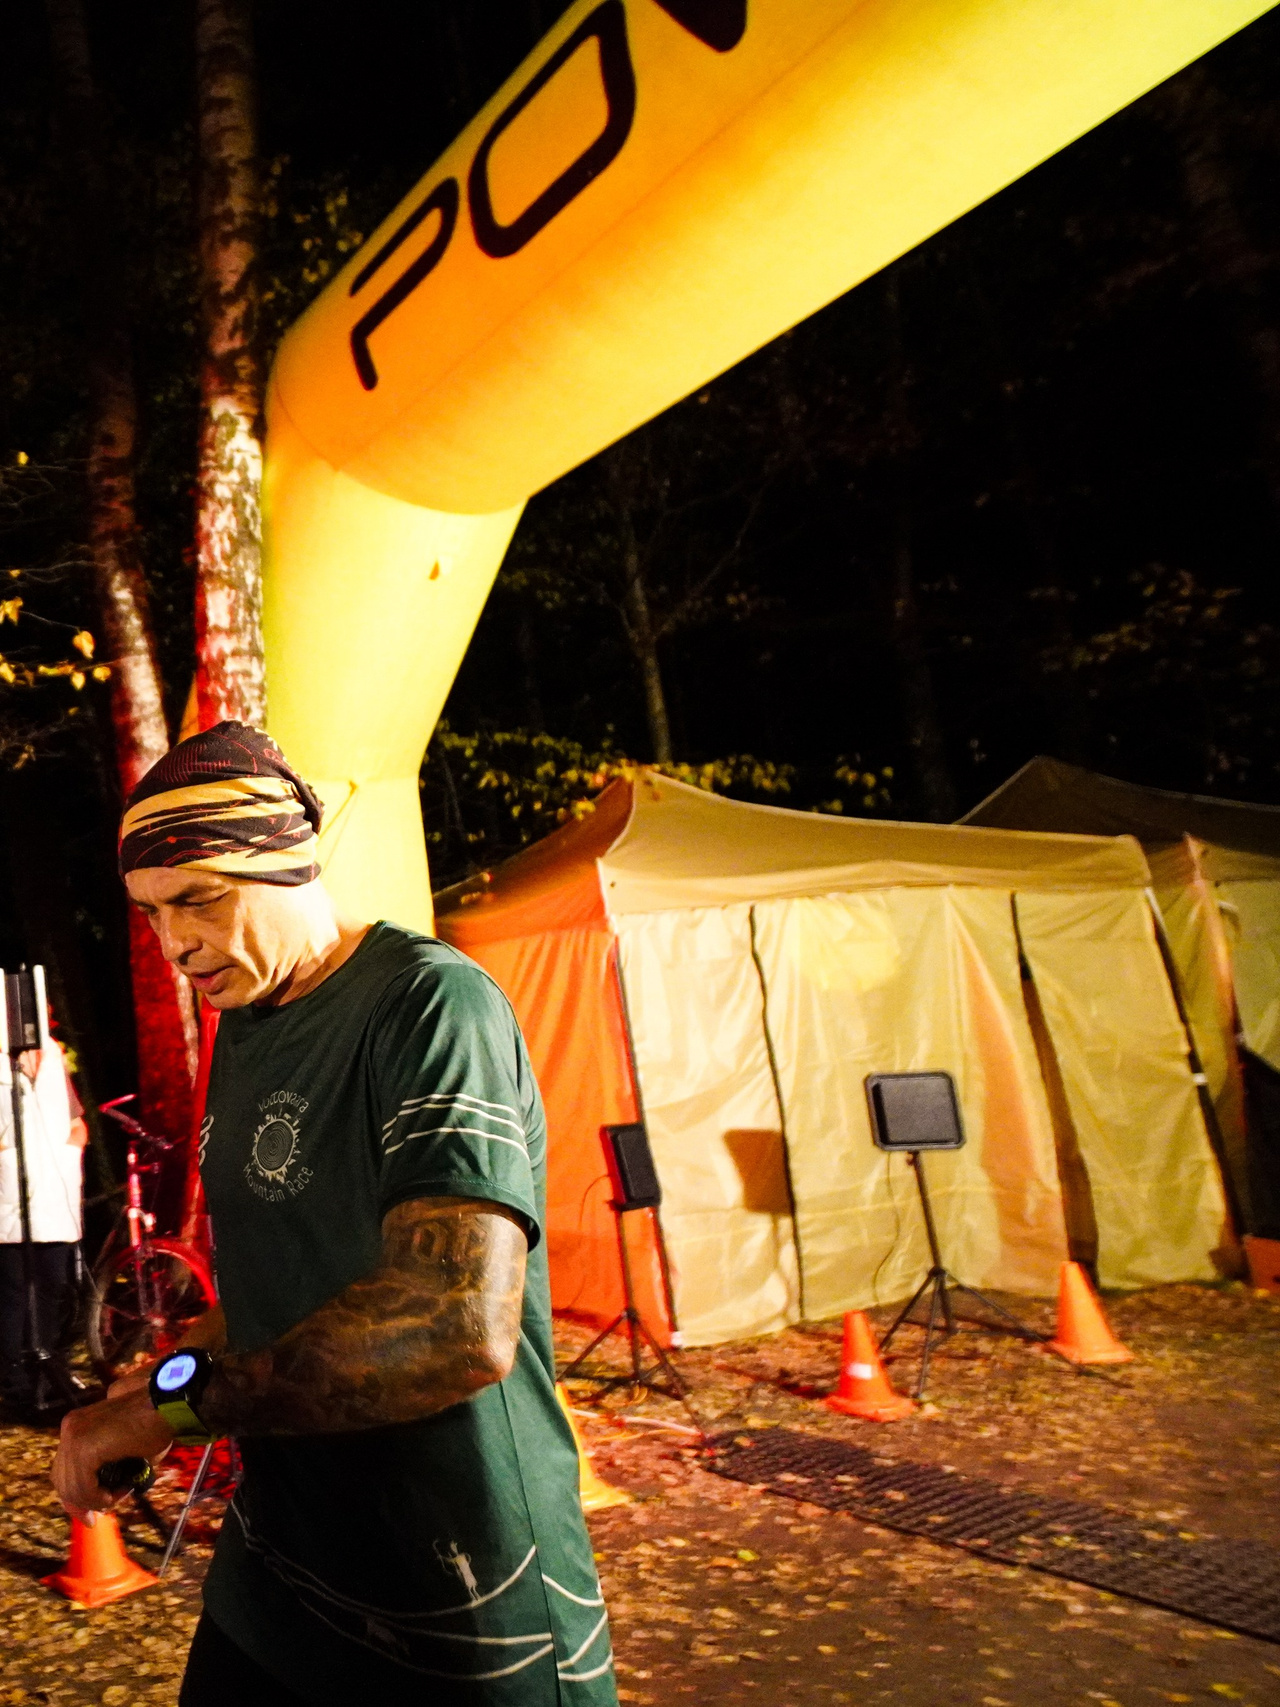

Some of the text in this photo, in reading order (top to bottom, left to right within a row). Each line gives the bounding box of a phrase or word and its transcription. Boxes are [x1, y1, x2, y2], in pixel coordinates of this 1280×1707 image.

[349, 0, 748, 391] PO
[243, 1164, 314, 1202] Mountain Race
